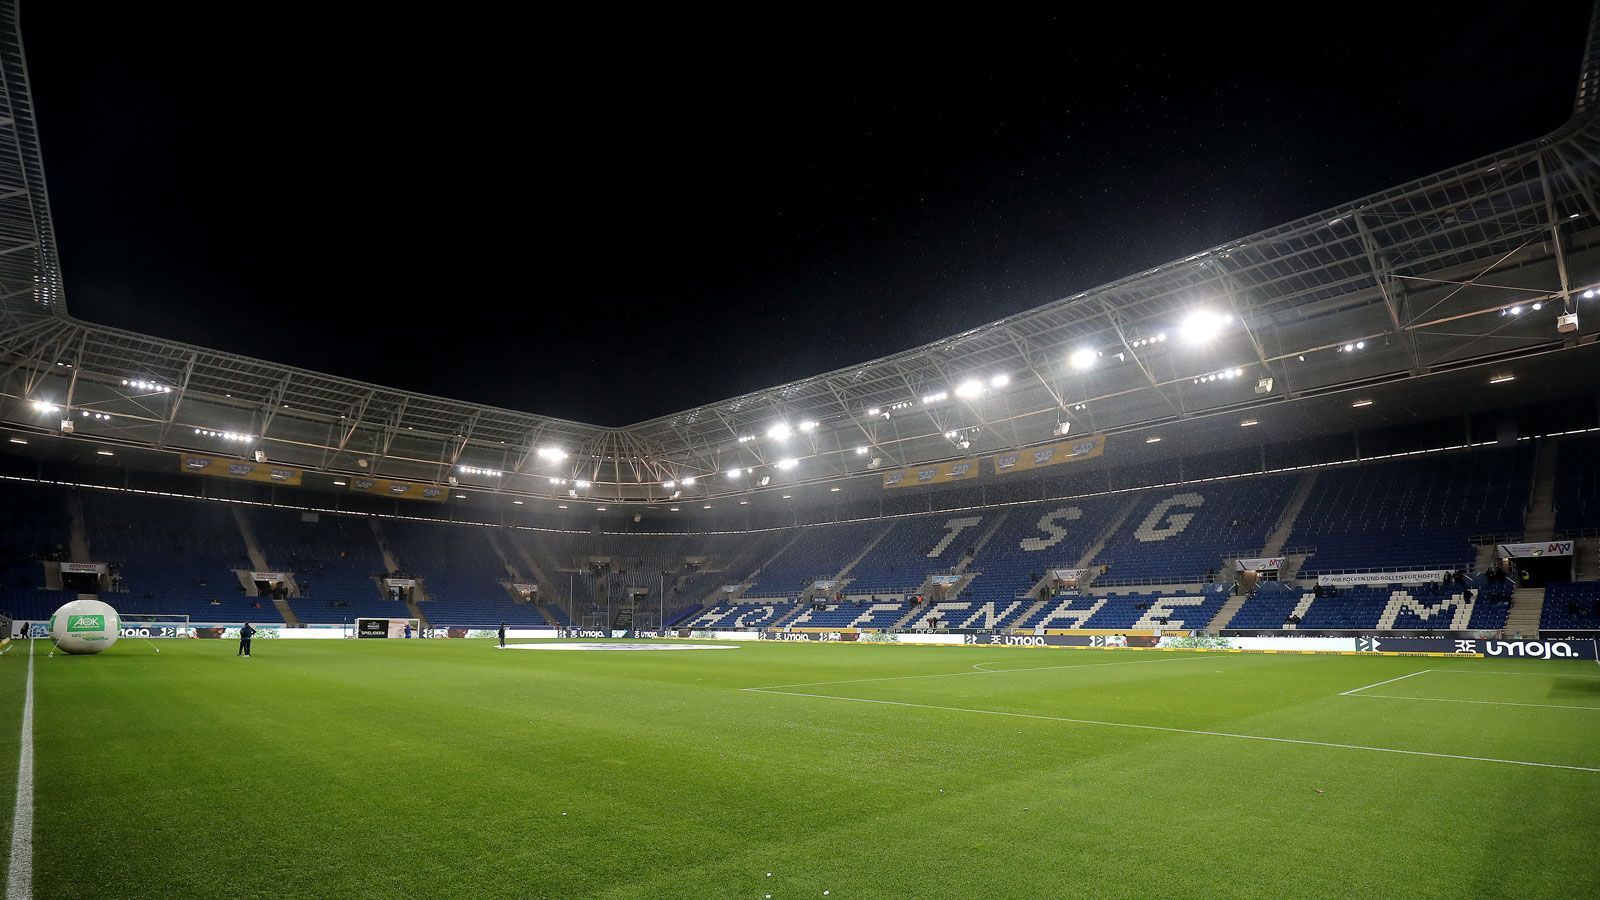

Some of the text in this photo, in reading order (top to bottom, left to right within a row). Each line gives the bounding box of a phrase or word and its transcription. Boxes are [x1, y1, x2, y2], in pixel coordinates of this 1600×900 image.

[1072, 443, 1094, 455] SAP
[999, 455, 1017, 468] SAP
[1034, 451, 1053, 464] SAP
[231, 464, 251, 475] SAP
[272, 470, 291, 480] SAP
[952, 465, 970, 476] SAP
[918, 470, 935, 481] SAP
[355, 480, 373, 489] SAP
[424, 488, 440, 498] SAP
[927, 493, 1204, 558] TSG
[74, 618, 99, 626] AOK
[612, 630, 626, 638] SAP
